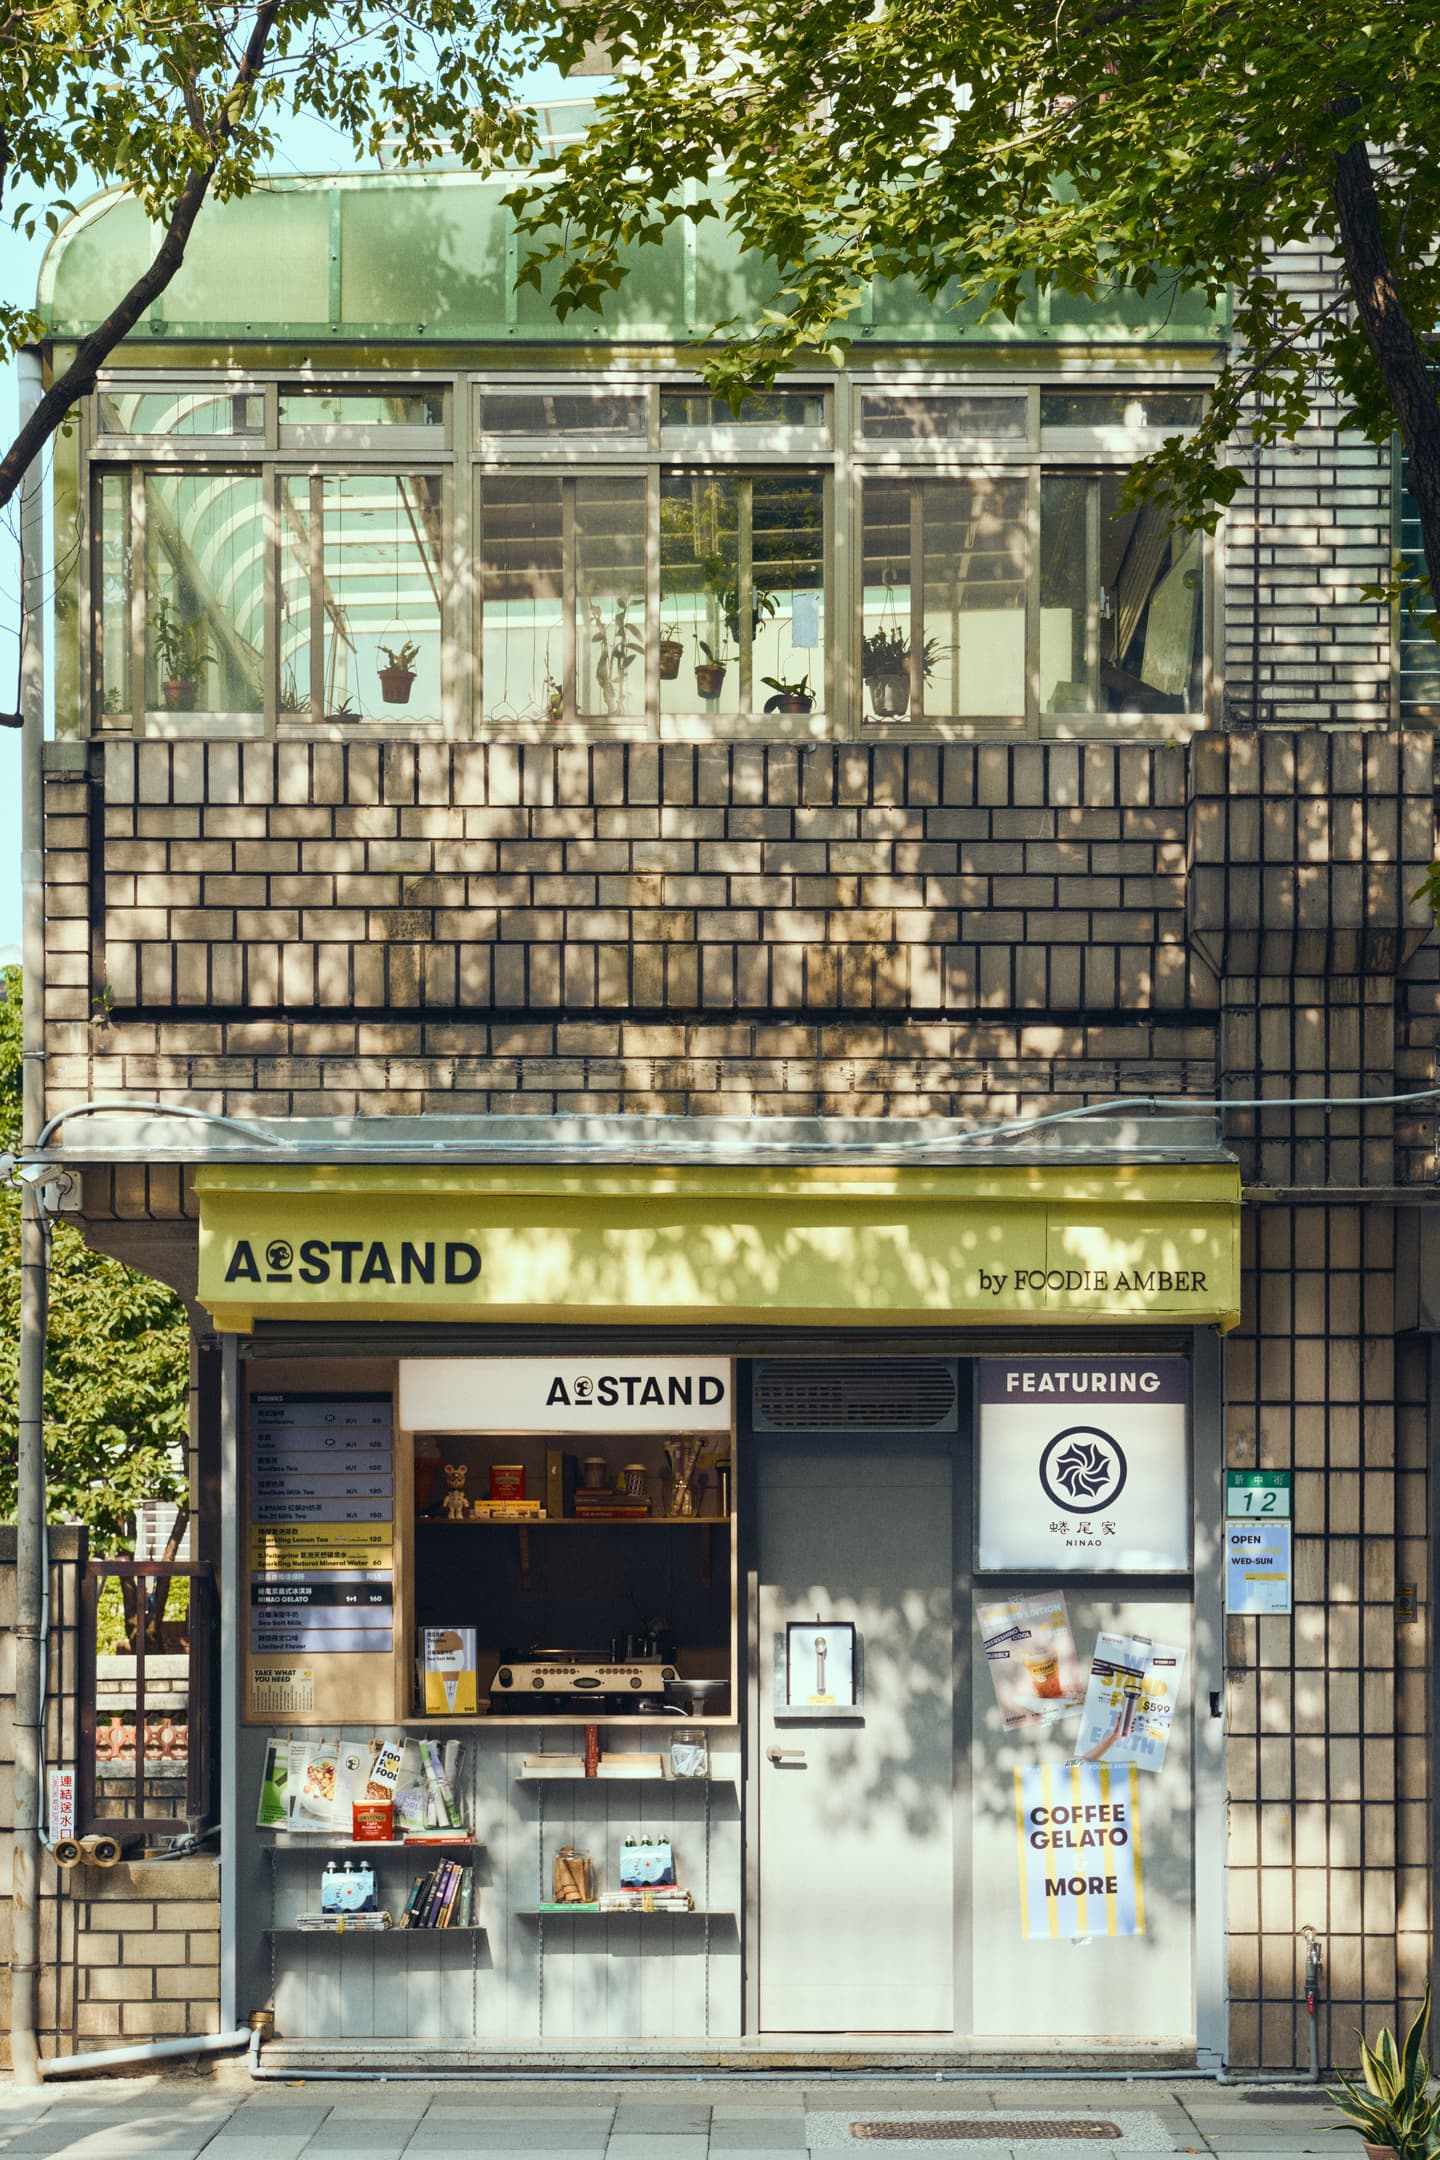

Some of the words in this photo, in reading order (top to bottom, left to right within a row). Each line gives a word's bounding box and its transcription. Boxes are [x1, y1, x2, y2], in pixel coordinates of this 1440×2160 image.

[979, 1269, 1008, 1295] by
[1014, 1270, 1108, 1292] FOODIE
[1114, 1271, 1208, 1293] AMBER
[1006, 1372, 1161, 1393] FEATURING
[1244, 1492, 1277, 1512] 12
[1066, 1539, 1102, 1547] NINAO
[1231, 1535, 1261, 1544] OPEN
[1231, 1557, 1273, 1565] WED-SUN
[1143, 1701, 1170, 1714] $599
[60, 1775, 72, 1840] 連結送水口
[1031, 1804, 1125, 1825] COFFEE
[1030, 1828, 1128, 1850] GELATO
[1045, 1875, 1118, 1897] MORE
